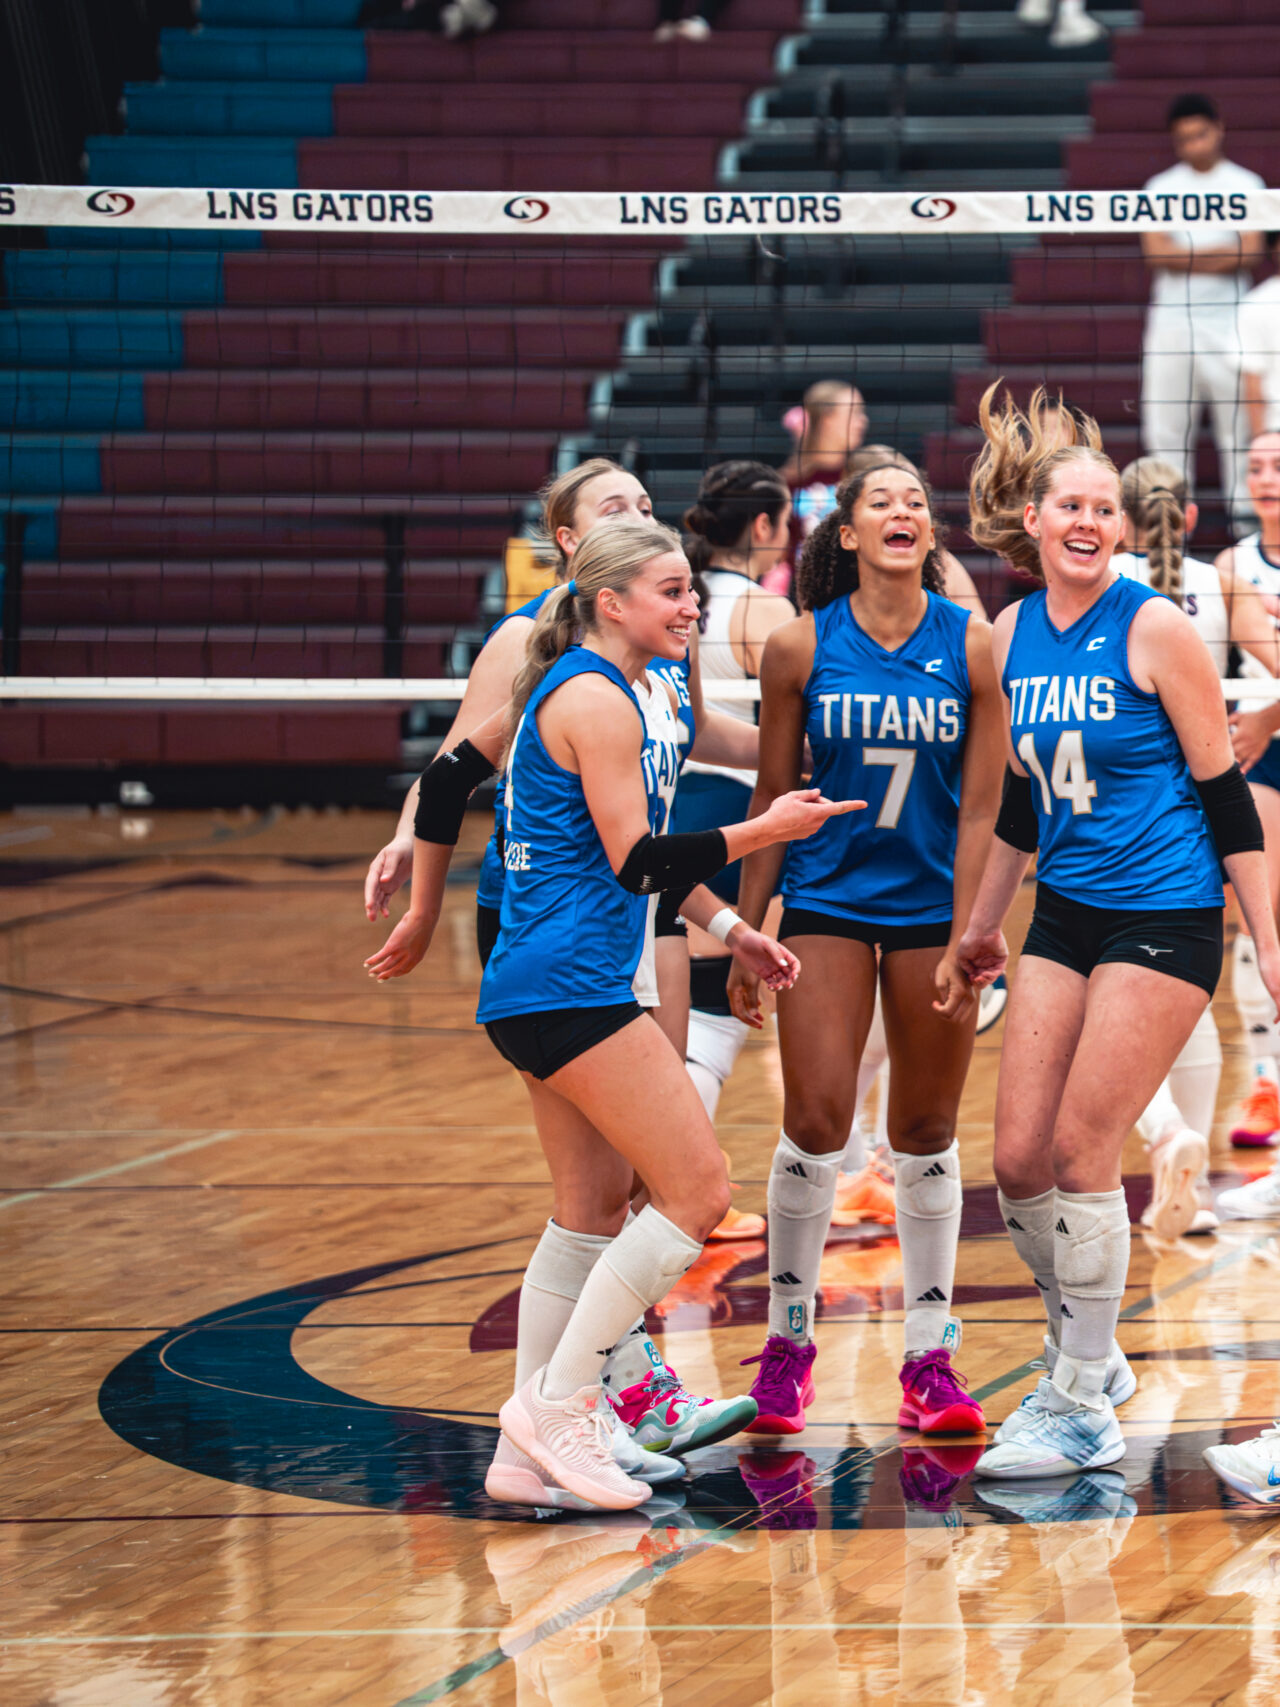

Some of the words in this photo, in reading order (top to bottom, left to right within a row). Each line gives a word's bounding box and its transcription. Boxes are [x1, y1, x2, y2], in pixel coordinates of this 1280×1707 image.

[207, 191, 278, 220] LNS
[292, 193, 434, 223] GATORS
[620, 196, 688, 224] LNS
[704, 196, 841, 224] GATORS
[1027, 195, 1094, 222] LNS
[1110, 194, 1248, 222] GATORS
[818, 693, 960, 743] TITANS
[1008, 675, 1116, 727] TITANS
[862, 746, 917, 830] 7
[1017, 730, 1098, 816] 14
